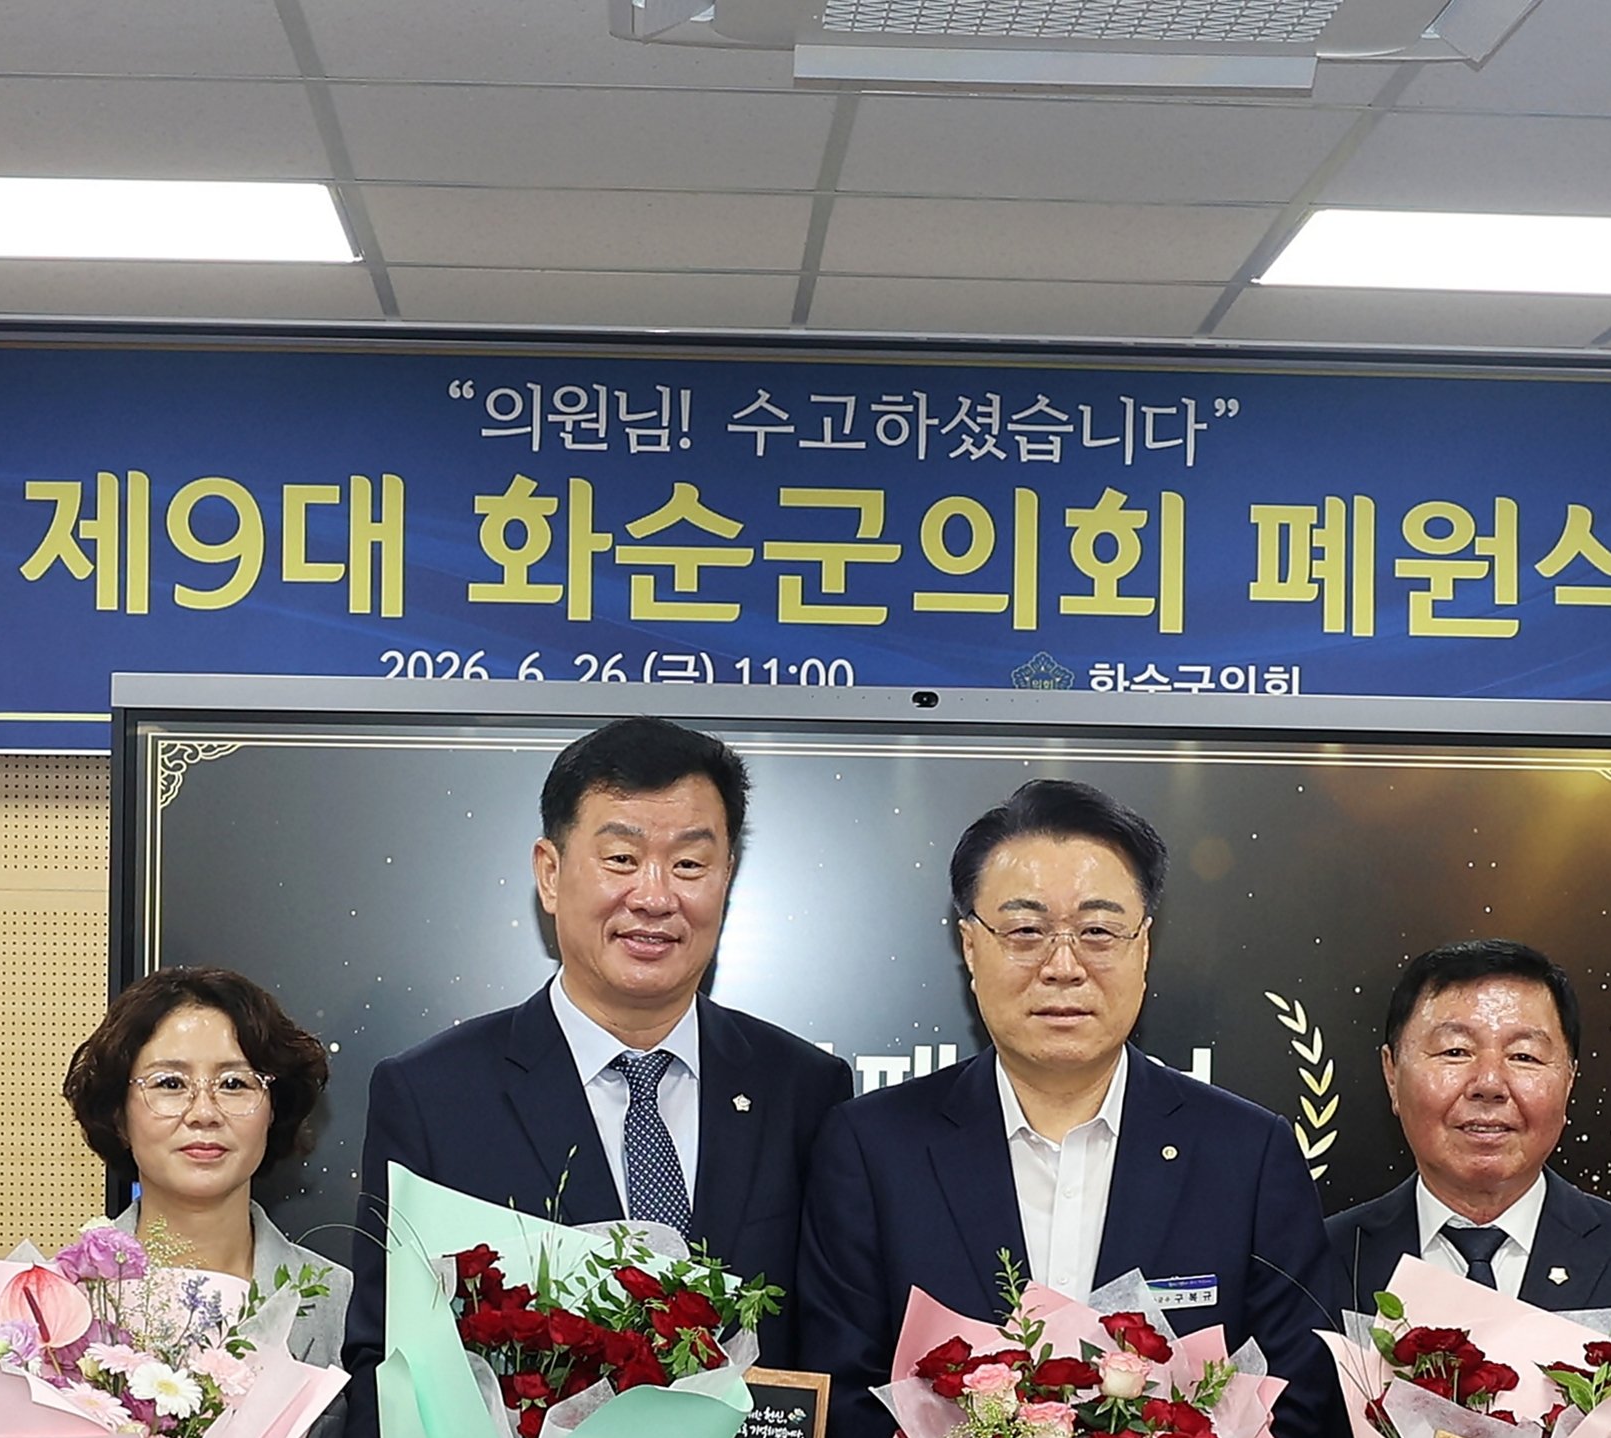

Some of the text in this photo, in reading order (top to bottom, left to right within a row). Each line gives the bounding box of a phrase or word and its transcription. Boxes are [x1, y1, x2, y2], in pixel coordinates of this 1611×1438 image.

[448, 379, 1240, 467] “의원님! 수고하셨습니다”
[20, 469, 405, 616] 제9대
[469, 474, 1185, 634] 화순군의회
